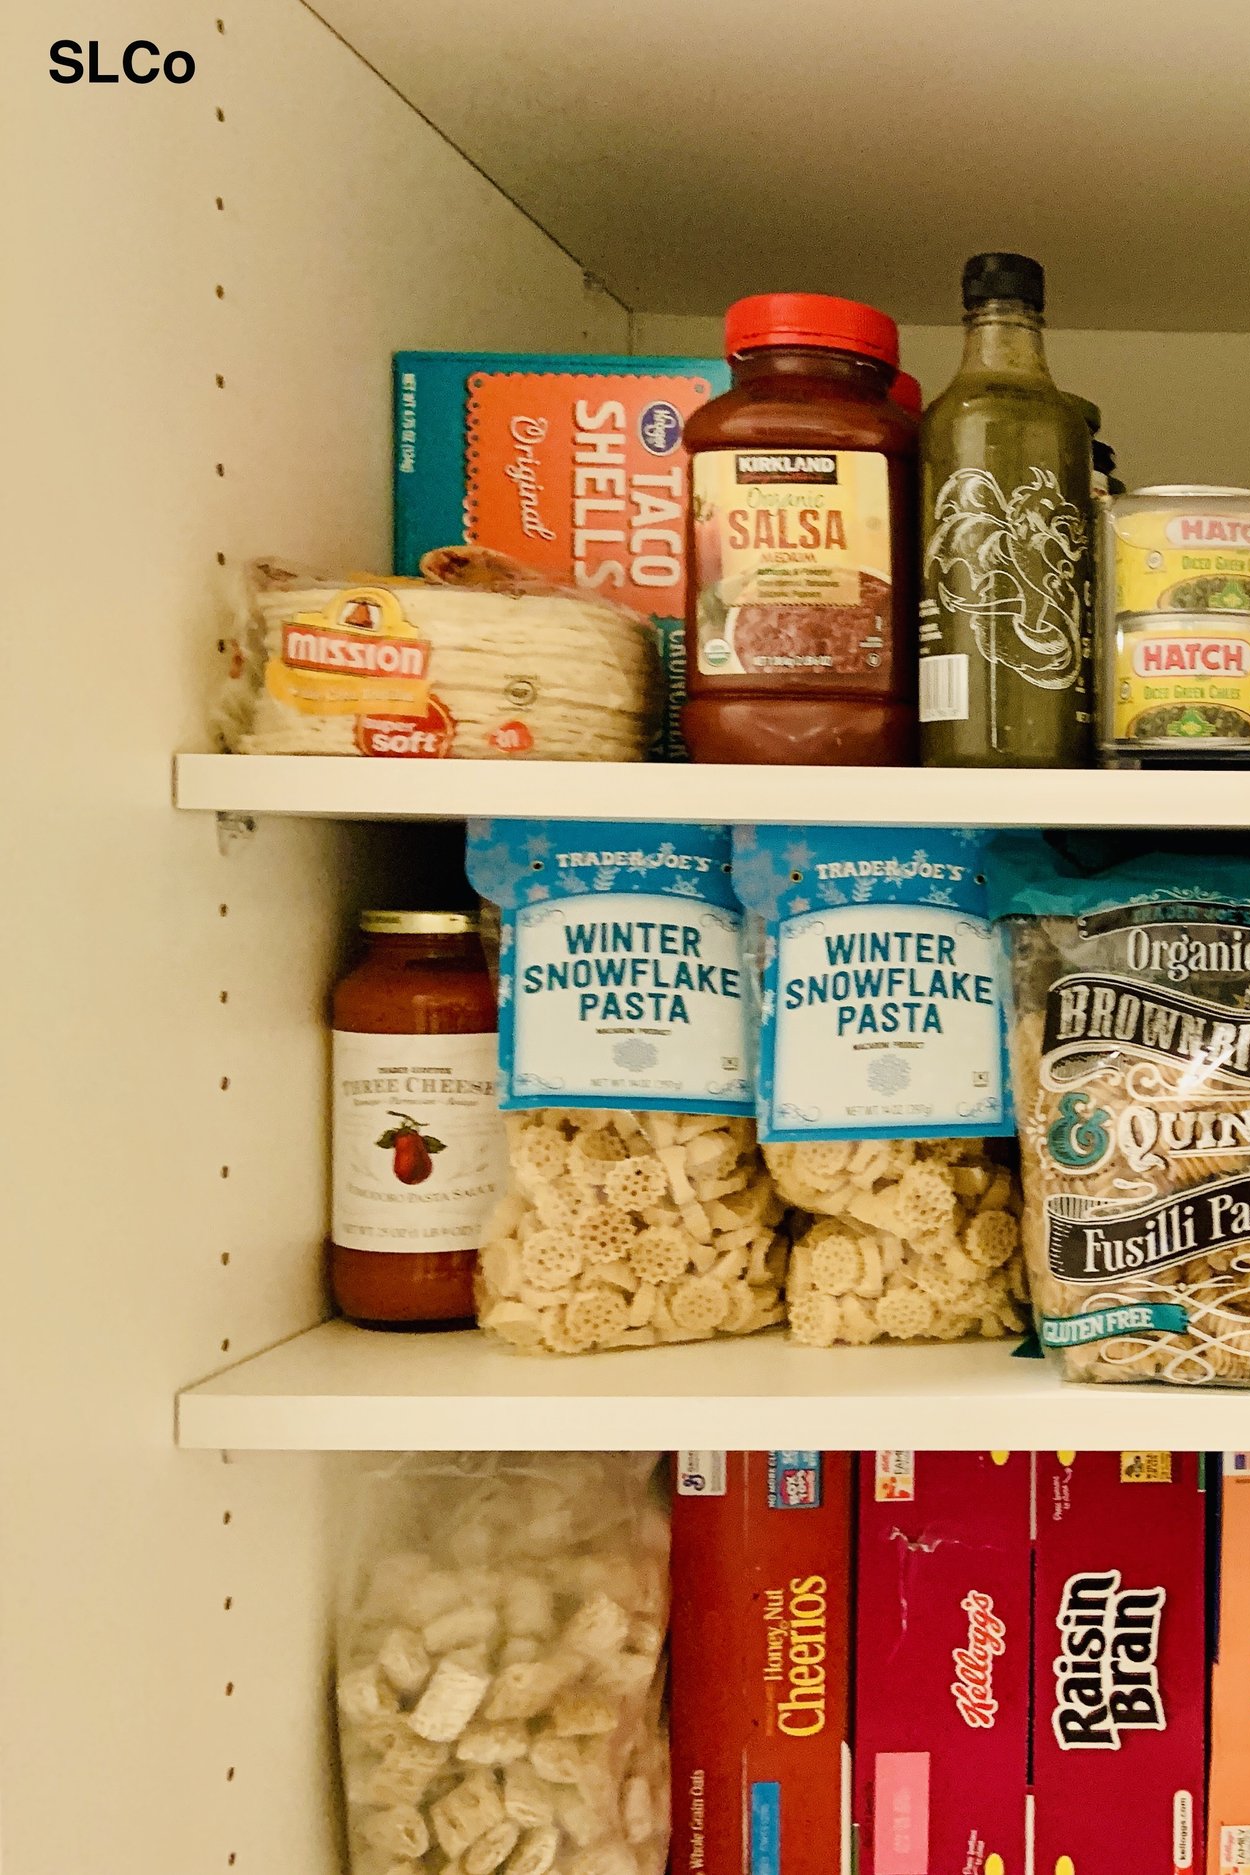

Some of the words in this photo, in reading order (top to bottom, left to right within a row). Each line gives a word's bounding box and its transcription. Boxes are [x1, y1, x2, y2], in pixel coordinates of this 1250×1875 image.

[504, 415, 556, 541] Original
[737, 456, 836, 474] KIRKLAND
[573, 399, 626, 588] SHELLS
[746, 487, 826, 517] Organic
[630, 466, 683, 588] TACO
[728, 509, 849, 551] SALSA
[286, 630, 426, 681] mission
[1143, 642, 1244, 672] HATCH
[370, 731, 439, 754] soft
[556, 851, 645, 869] TRADER
[647, 851, 713, 873] JOE'S
[815, 860, 897, 880] TRADER
[901, 860, 966, 882] JOE'S
[564, 921, 702, 958] WINTER
[825, 931, 957, 967] WINTER
[522, 957, 742, 999] SNOWFLAKE
[785, 967, 994, 1010] SNOWFLAKE
[578, 991, 691, 1025] PASTA
[837, 1002, 944, 1037] PASTA
[1056, 985, 1204, 1061] BROWN
[342, 1078, 400, 1097] THREE
[405, 1076, 495, 1096] CHEESE
[1046, 1092, 1110, 1168] &
[1082, 1204, 1198, 1273] Fusilli
[1042, 1313, 1104, 1342] GLUTEN
[1106, 1306, 1156, 1330] FREE
[763, 1588, 784, 1621] Nut
[763, 1628, 789, 1681] Honey
[777, 1574, 828, 1738] Cheerios
[955, 1592, 1003, 1727] Kellogg's
[1058, 1572, 1120, 1746] Raisin
[1110, 1590, 1162, 1727] Bran
[688, 1769, 705, 1797] Oats
[689, 1798, 704, 1832] Grain
[1177, 1796, 1188, 1862] kelloggs.com
[689, 1832, 704, 1869] Whole
